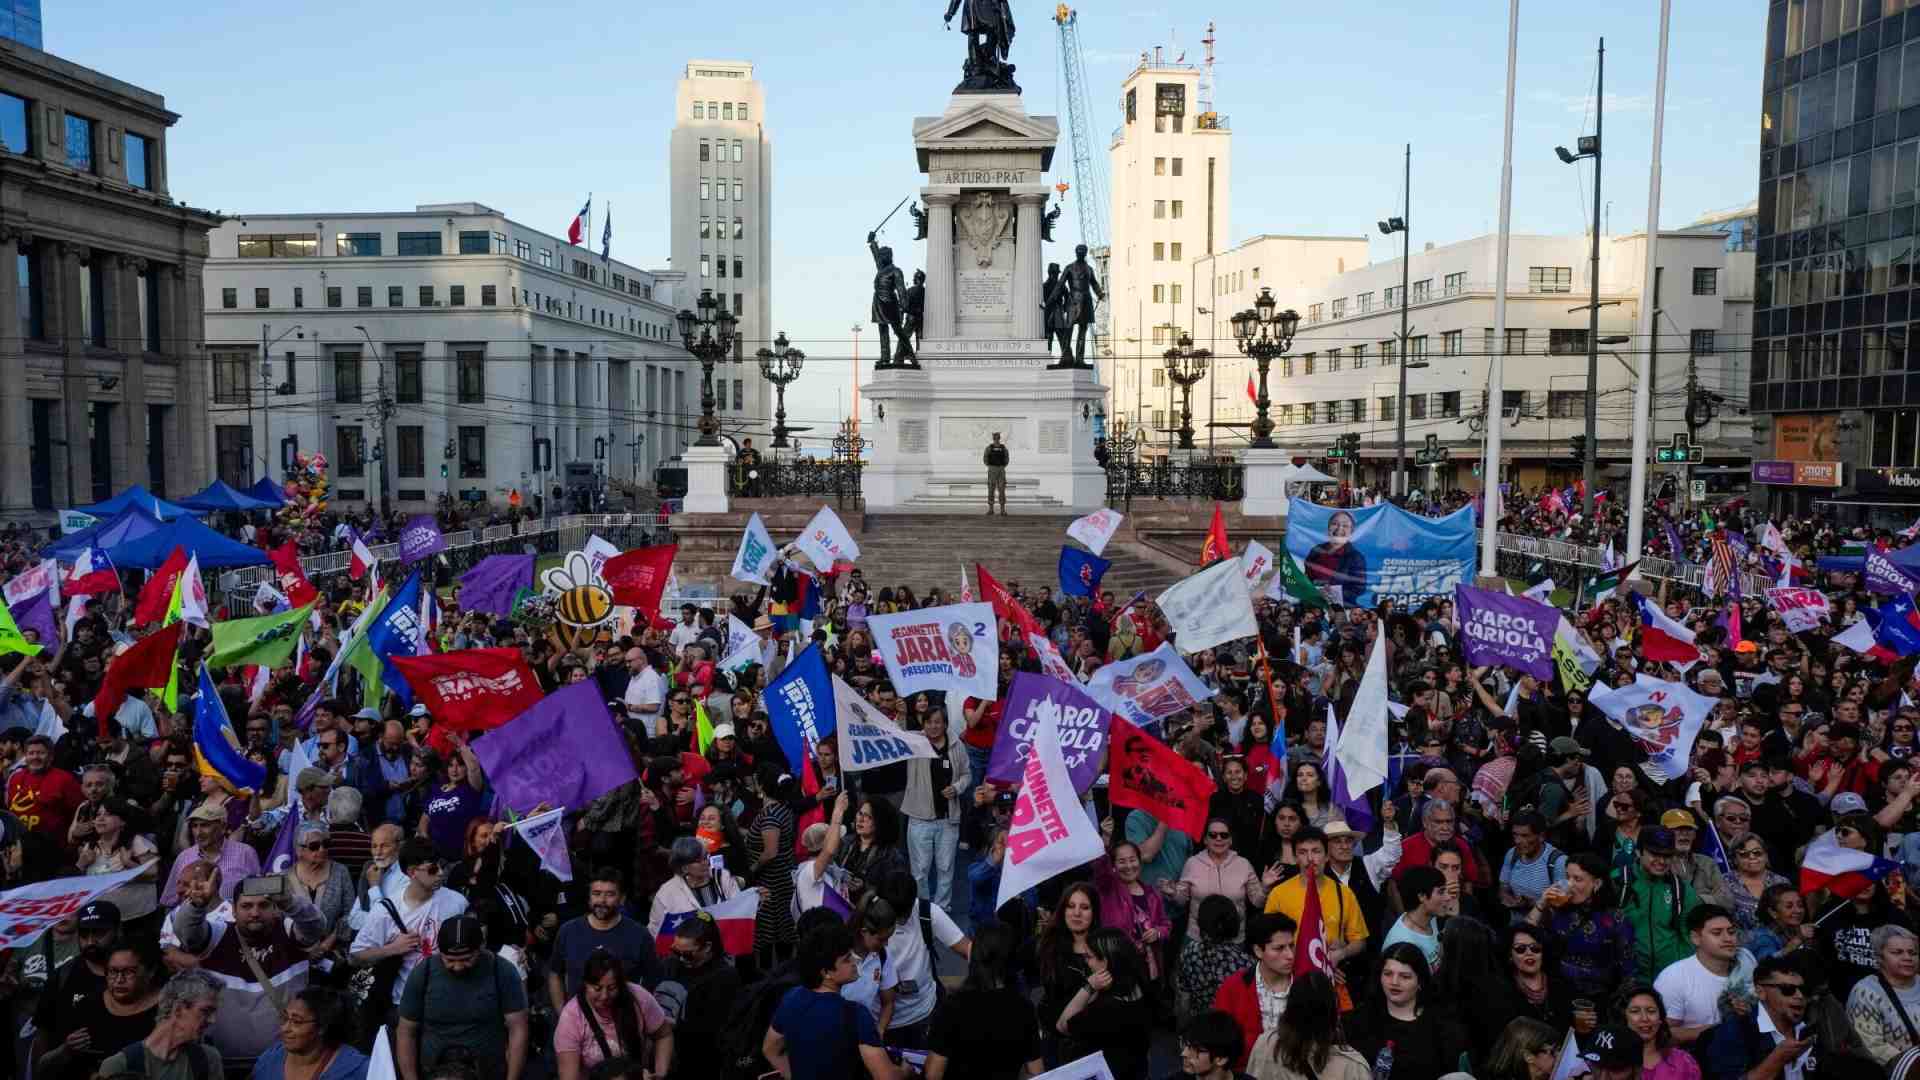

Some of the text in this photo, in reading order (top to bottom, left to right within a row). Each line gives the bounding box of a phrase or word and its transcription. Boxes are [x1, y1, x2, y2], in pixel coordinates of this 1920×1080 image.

[996, 171, 1025, 184] PRAT
[974, 622, 986, 636] 2
[1464, 620, 1546, 653] CARIOLA
[895, 636, 952, 666] JARA
[901, 663, 953, 678] PRESIDENTA
[1009, 718, 1103, 752] CAOLA
[852, 736, 913, 764] JARA
